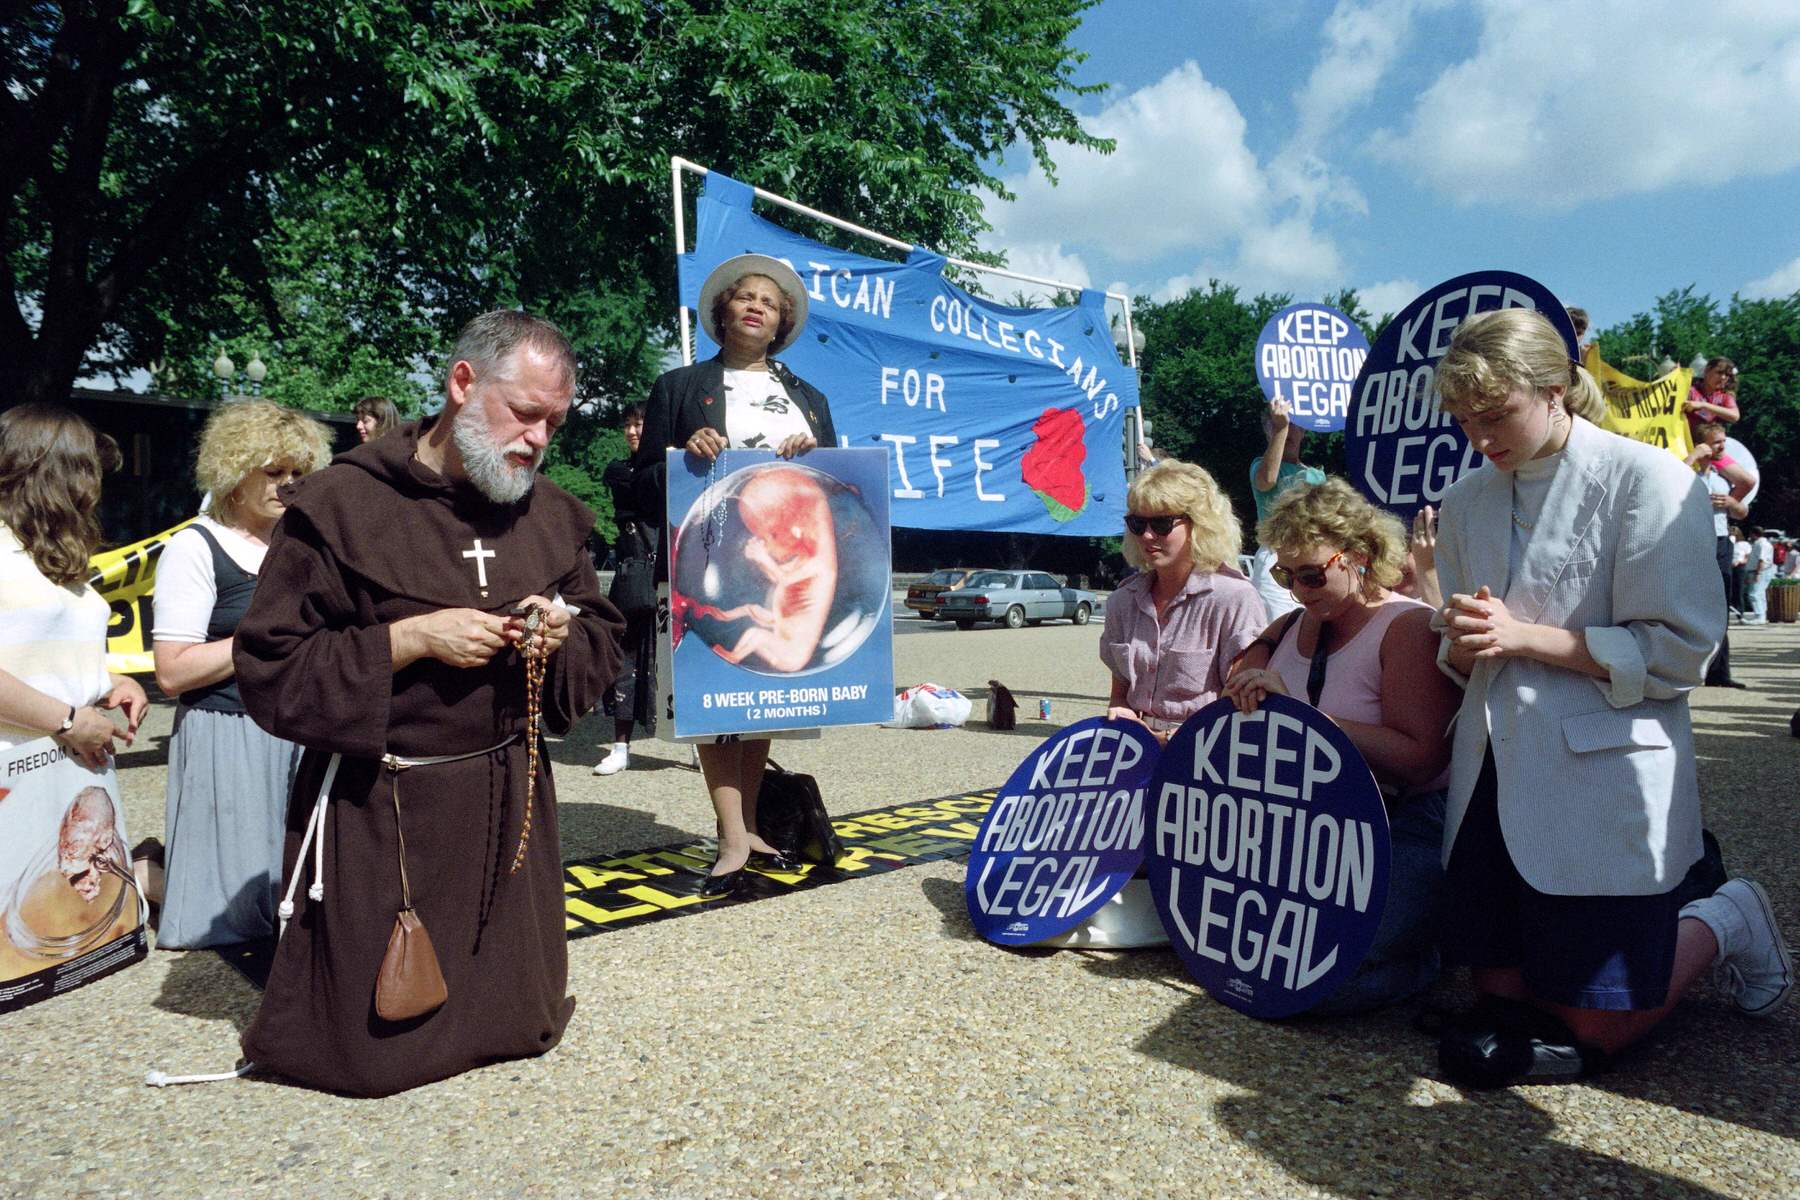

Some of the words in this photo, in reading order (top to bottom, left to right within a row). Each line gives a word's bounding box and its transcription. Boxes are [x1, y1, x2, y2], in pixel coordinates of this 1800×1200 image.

[783, 258, 895, 320] ICAN
[930, 294, 1119, 420] COLLEGIANS
[1278, 309, 1349, 345] KEEP
[881, 366, 946, 413] FOR
[1261, 343, 1368, 382] ABORTION
[842, 434, 1007, 502] IFE
[703, 693, 712, 709] 8
[715, 691, 755, 708] WEEK
[759, 687, 828, 705] PRE-BORN
[832, 684, 868, 701] BABY
[1028, 728, 1144, 791] KEEP
[1193, 710, 1342, 802] KEEP
[980, 787, 1149, 853] ABORTION
[1156, 782, 1375, 914] ABORTION
[976, 855, 1111, 918] LEGAL
[1169, 867, 1339, 992] LEGAL
